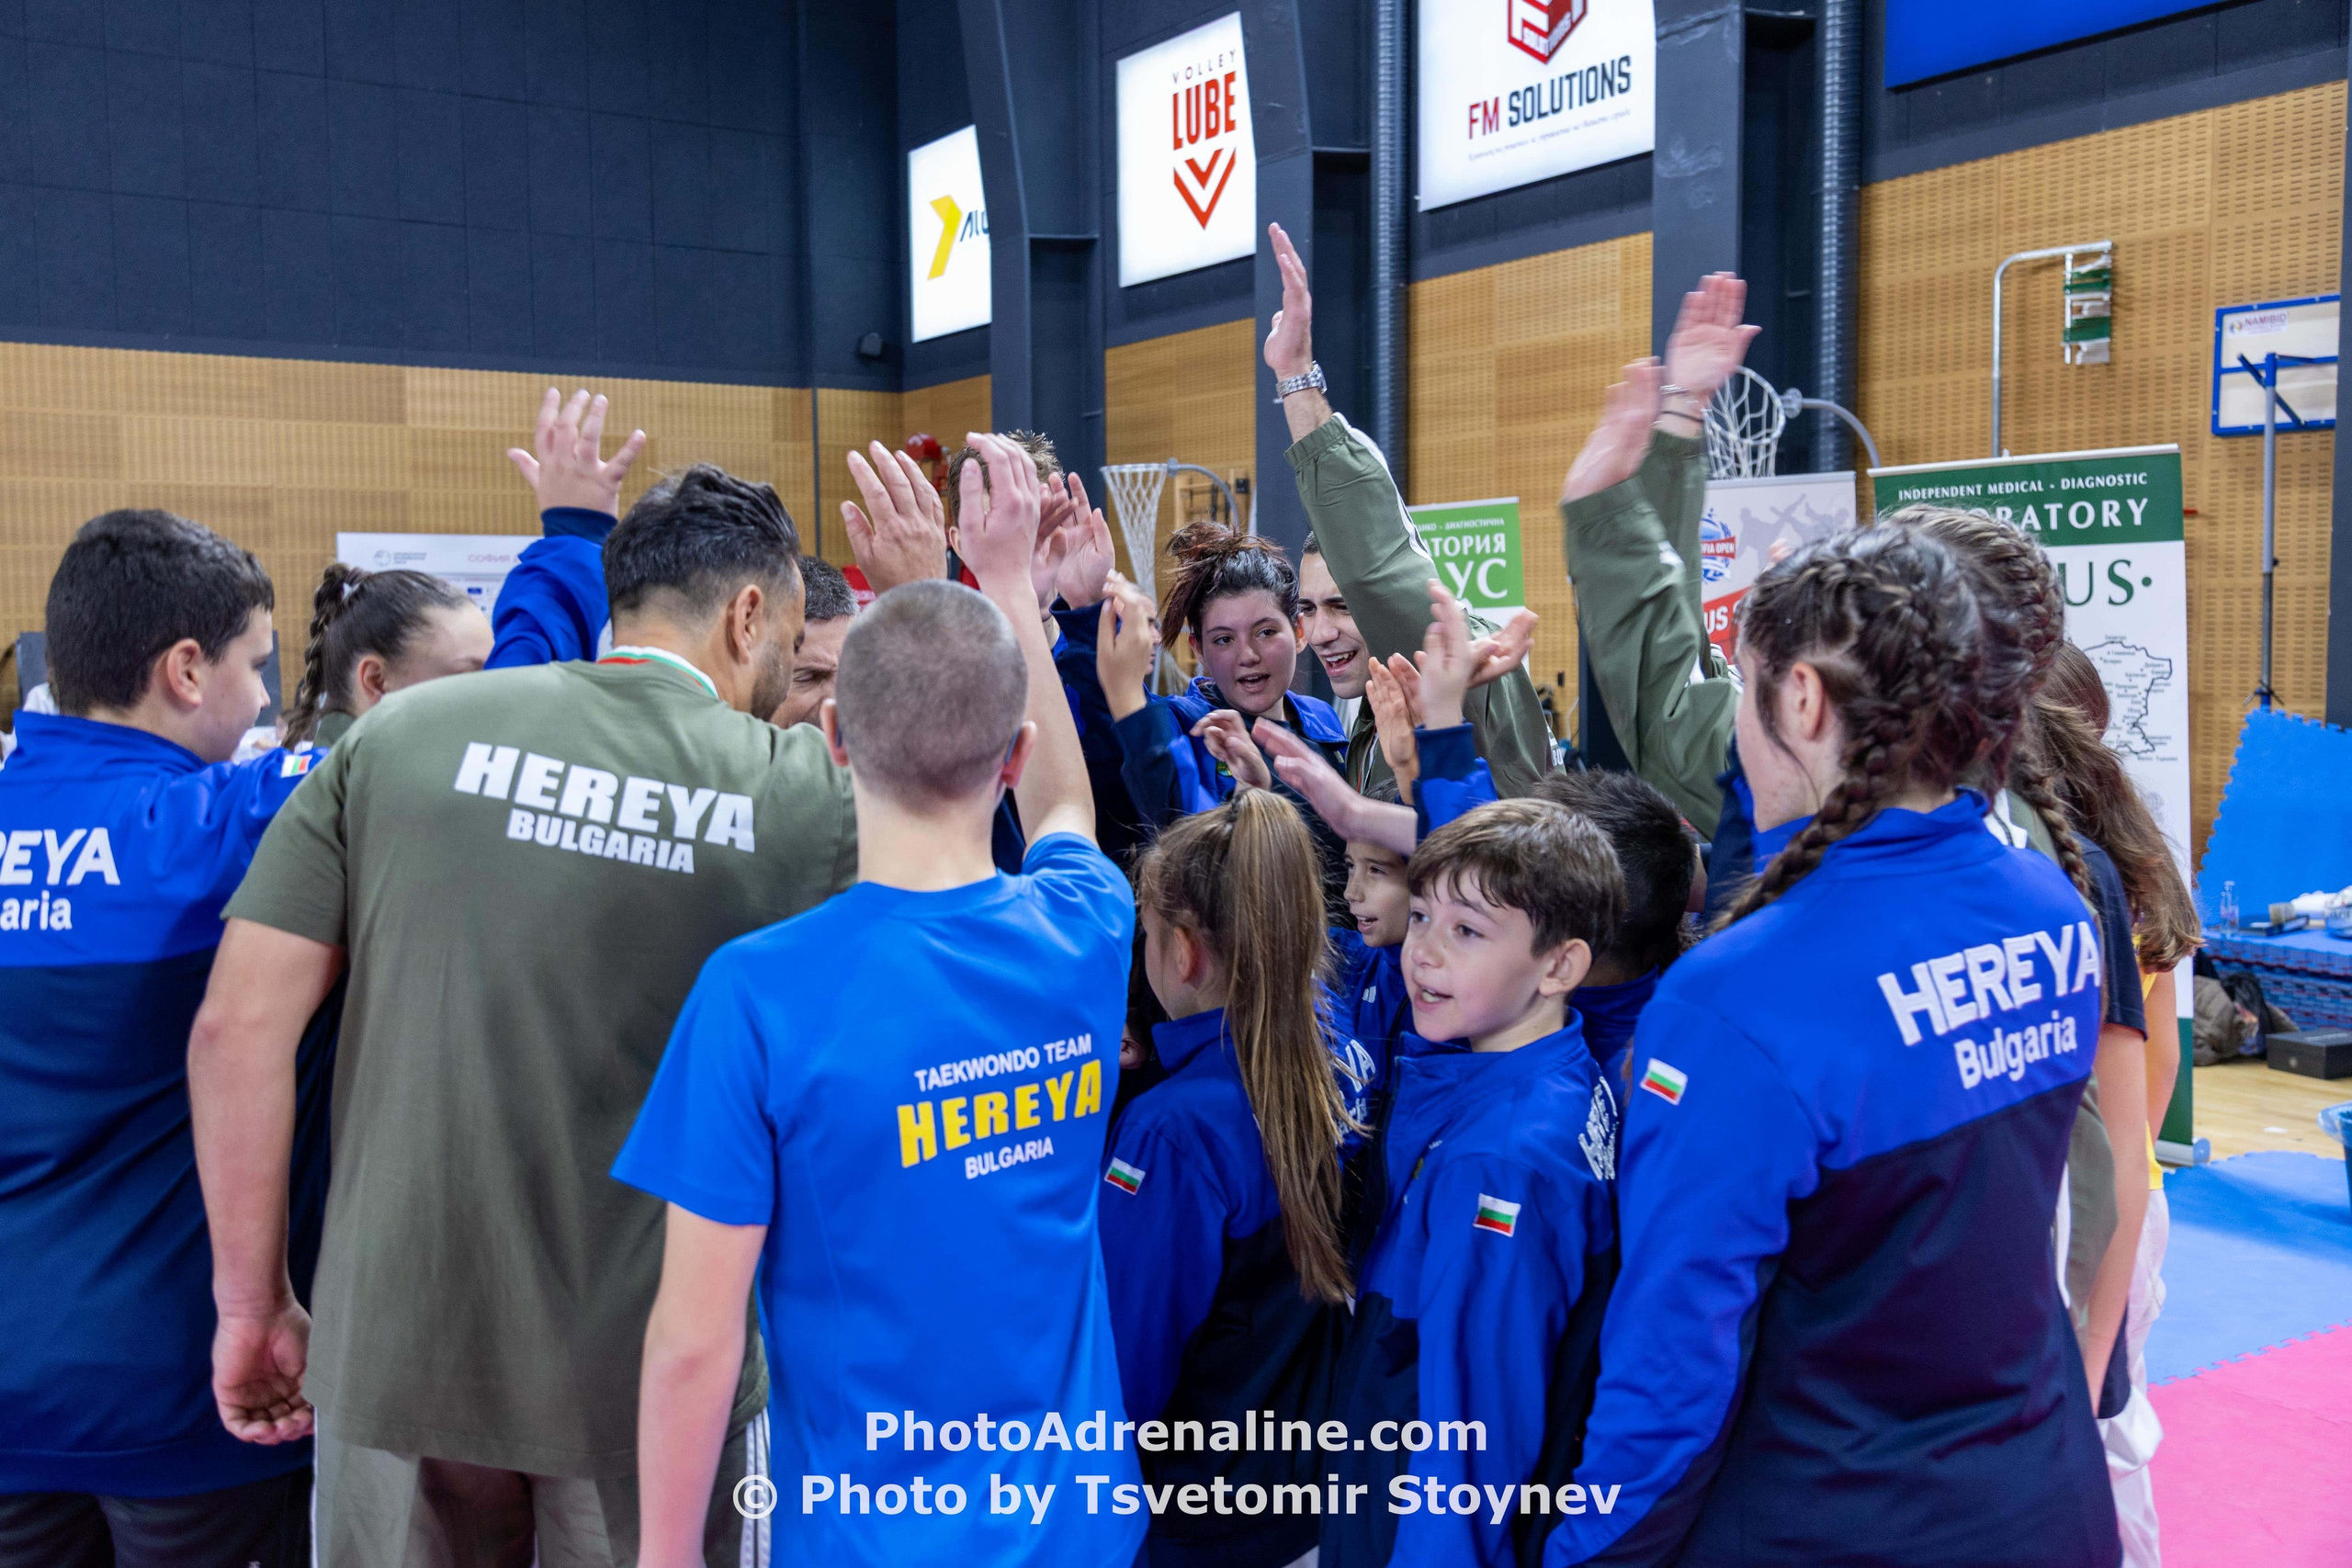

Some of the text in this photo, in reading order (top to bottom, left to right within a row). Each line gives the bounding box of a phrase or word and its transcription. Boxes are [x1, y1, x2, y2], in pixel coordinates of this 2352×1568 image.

[1172, 50, 1236, 85] VOLLEY
[1468, 96, 1499, 140] FM
[1509, 55, 1632, 128] SOLUTIONS
[1172, 71, 1237, 152] LUBE
[1898, 484, 1983, 501] INDEPENDENT
[1987, 479, 2044, 495] MEDICAL
[2060, 471, 2148, 491] DIAGNOSTIC
[454, 741, 756, 853] HEREYA
[0, 827, 120, 886] EYA
[507, 807, 695, 874] BULGARIA
[1877, 920, 2101, 1046] HEREYA
[914, 1032, 1091, 1092] TAEKWONDO TEAM
[1953, 1010, 2078, 1089] Bulgaria
[897, 1059, 1102, 1168] HEREYA
[965, 1136, 1054, 1180] BULGARIA
